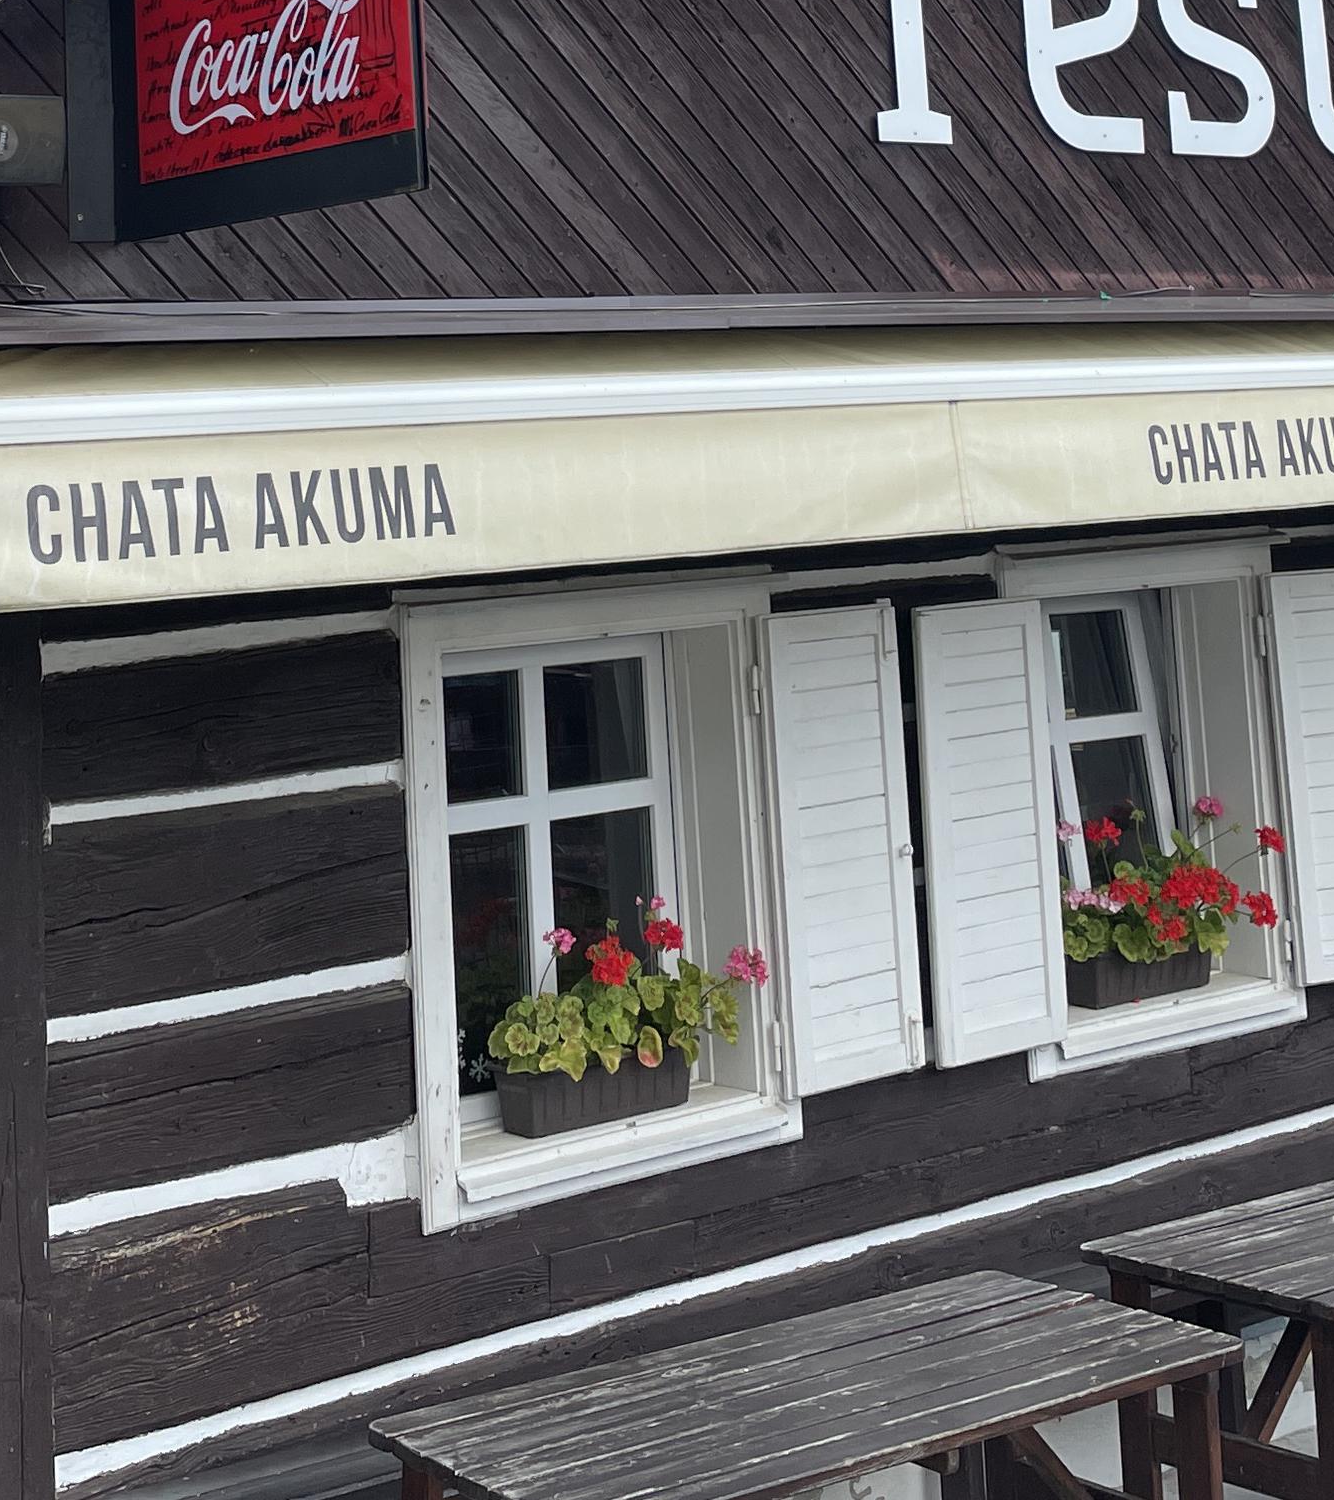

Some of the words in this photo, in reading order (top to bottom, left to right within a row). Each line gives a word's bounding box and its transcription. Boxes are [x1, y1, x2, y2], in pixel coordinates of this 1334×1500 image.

[1147, 420, 1267, 486] CHATA
[26, 475, 229, 565] CHATA
[254, 462, 457, 551] AKUMA
